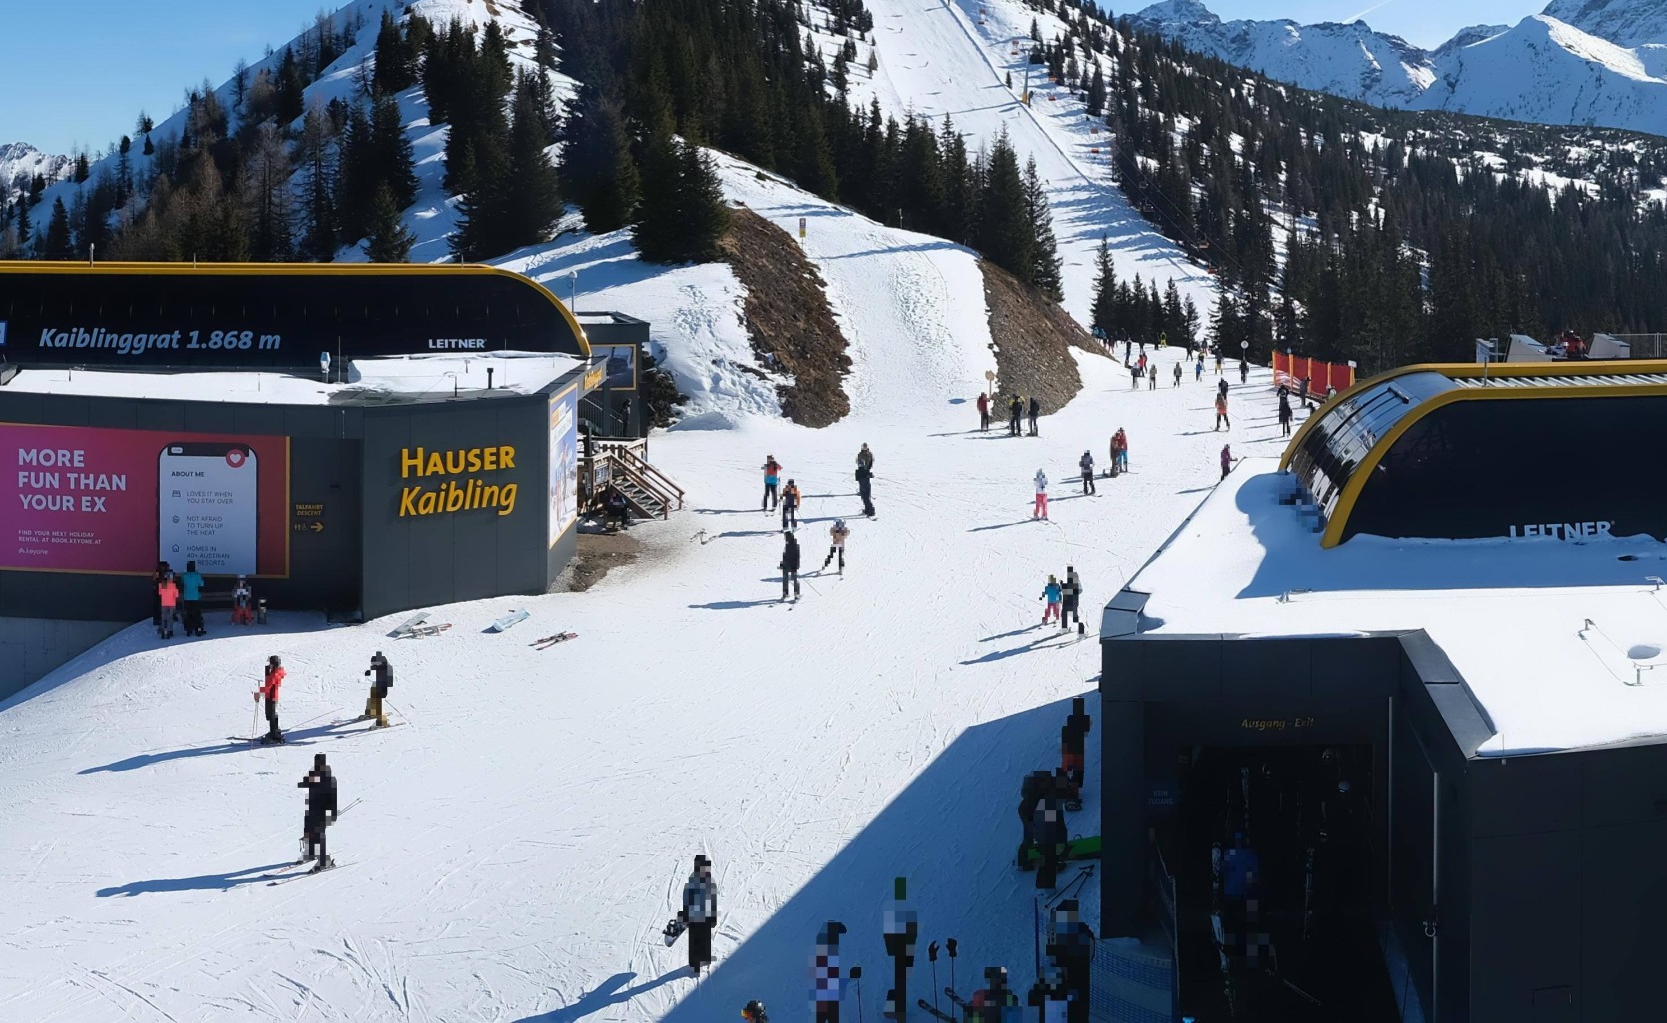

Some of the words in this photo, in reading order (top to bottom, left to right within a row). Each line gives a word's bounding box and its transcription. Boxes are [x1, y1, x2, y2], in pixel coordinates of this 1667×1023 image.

[39, 328, 181, 355] Kaiblinggrat
[187, 330, 253, 350] 1.868
[258, 335, 281, 350] m
[428, 339, 486, 349] LEITNER
[18, 448, 85, 468] MORE
[402, 445, 516, 478] HAUSER
[18, 471, 60, 489] FUN
[67, 473, 127, 491] THAN
[19, 494, 75, 511] YOUR
[81, 497, 107, 513] EX
[400, 479, 518, 517] Kaibling
[1242, 719, 1286, 731] Ausgang
[1295, 717, 1314, 728] Exit
